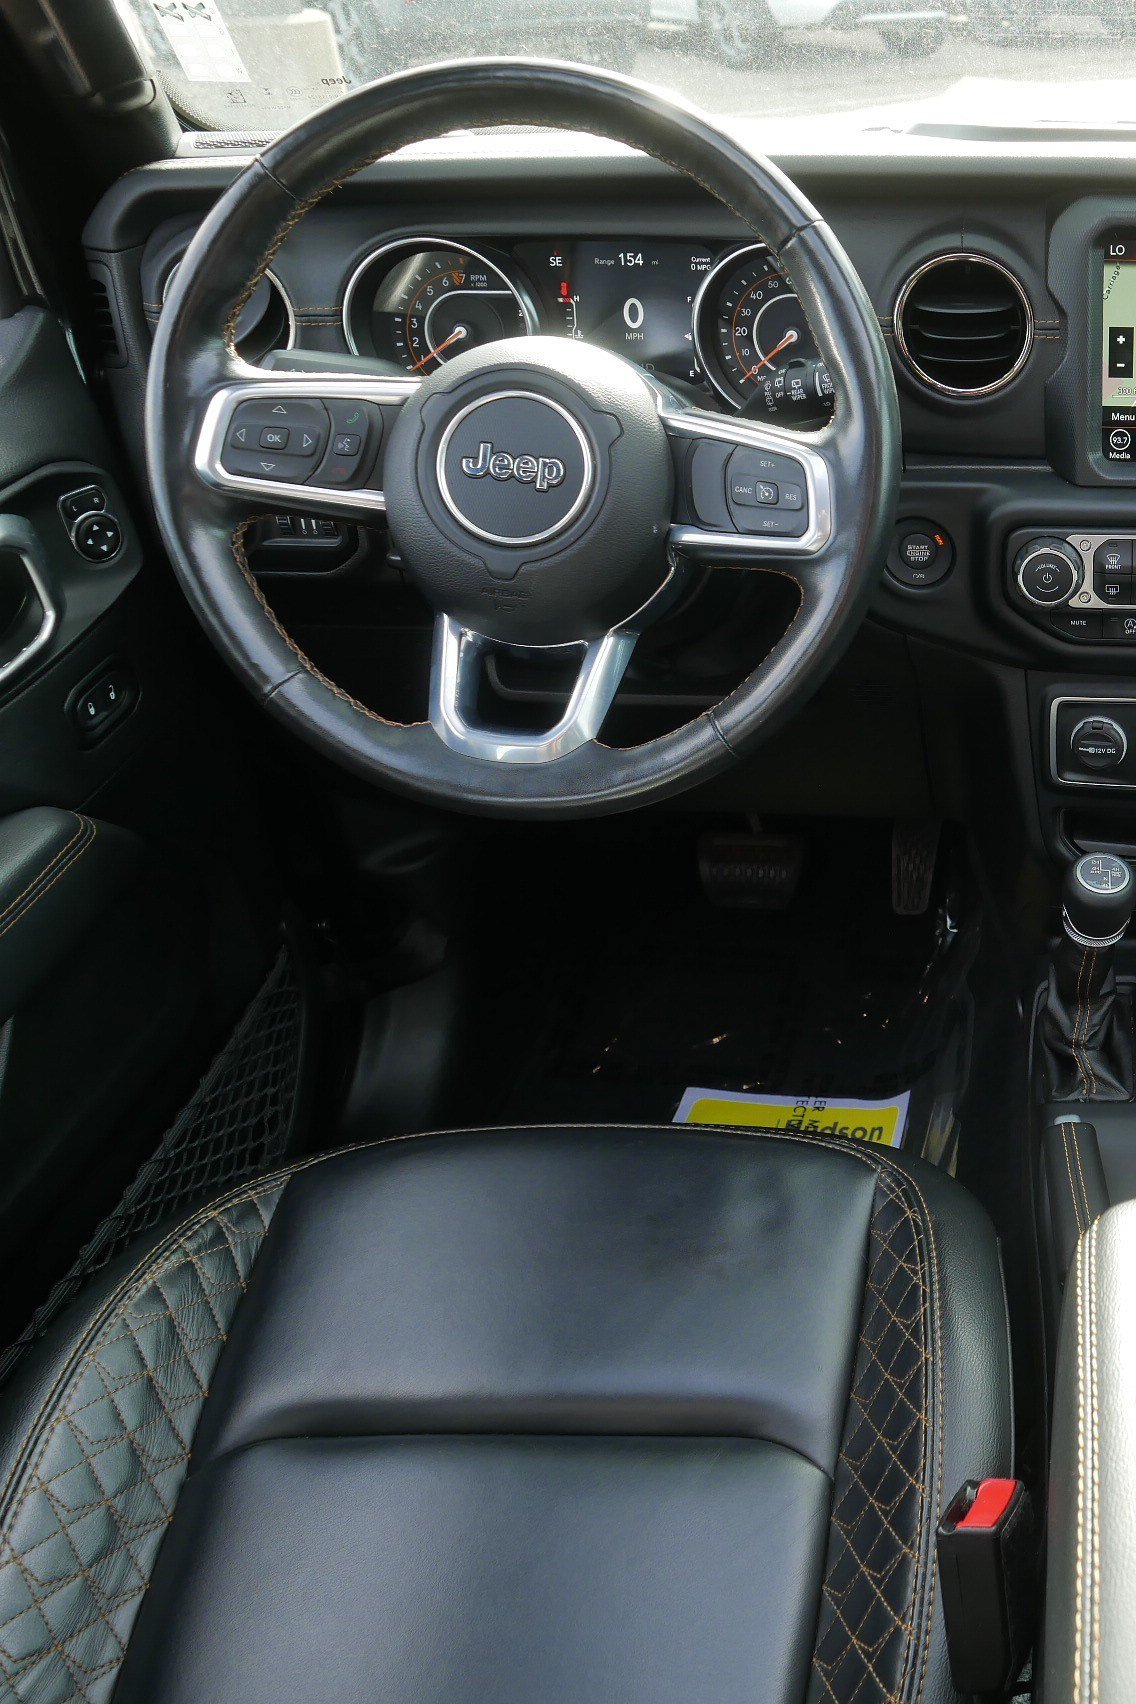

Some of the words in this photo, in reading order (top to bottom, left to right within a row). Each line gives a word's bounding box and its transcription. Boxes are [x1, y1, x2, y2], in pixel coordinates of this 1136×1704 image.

[1109, 244, 1126, 256] LO
[549, 256, 563, 267] SE
[594, 257, 615, 266] Range
[618, 252, 644, 266] 154
[442, 277, 449, 287] 6
[767, 280, 779, 289] 50
[426, 286, 434, 296] 5
[750, 290, 763, 300] 40
[415, 301, 422, 311] 4
[623, 297, 644, 329] 0
[740, 307, 751, 317] 30
[410, 318, 418, 329] 3
[735, 326, 748, 336] 20
[412, 338, 420, 348] 2
[741, 348, 750, 357] 10
[1111, 413, 1136, 421] Menu
[267, 434, 281, 442] OK
[1112, 436, 1128, 444] 93.7
[462, 440, 566, 492] Jeep
[734, 485, 753, 494] CANC
